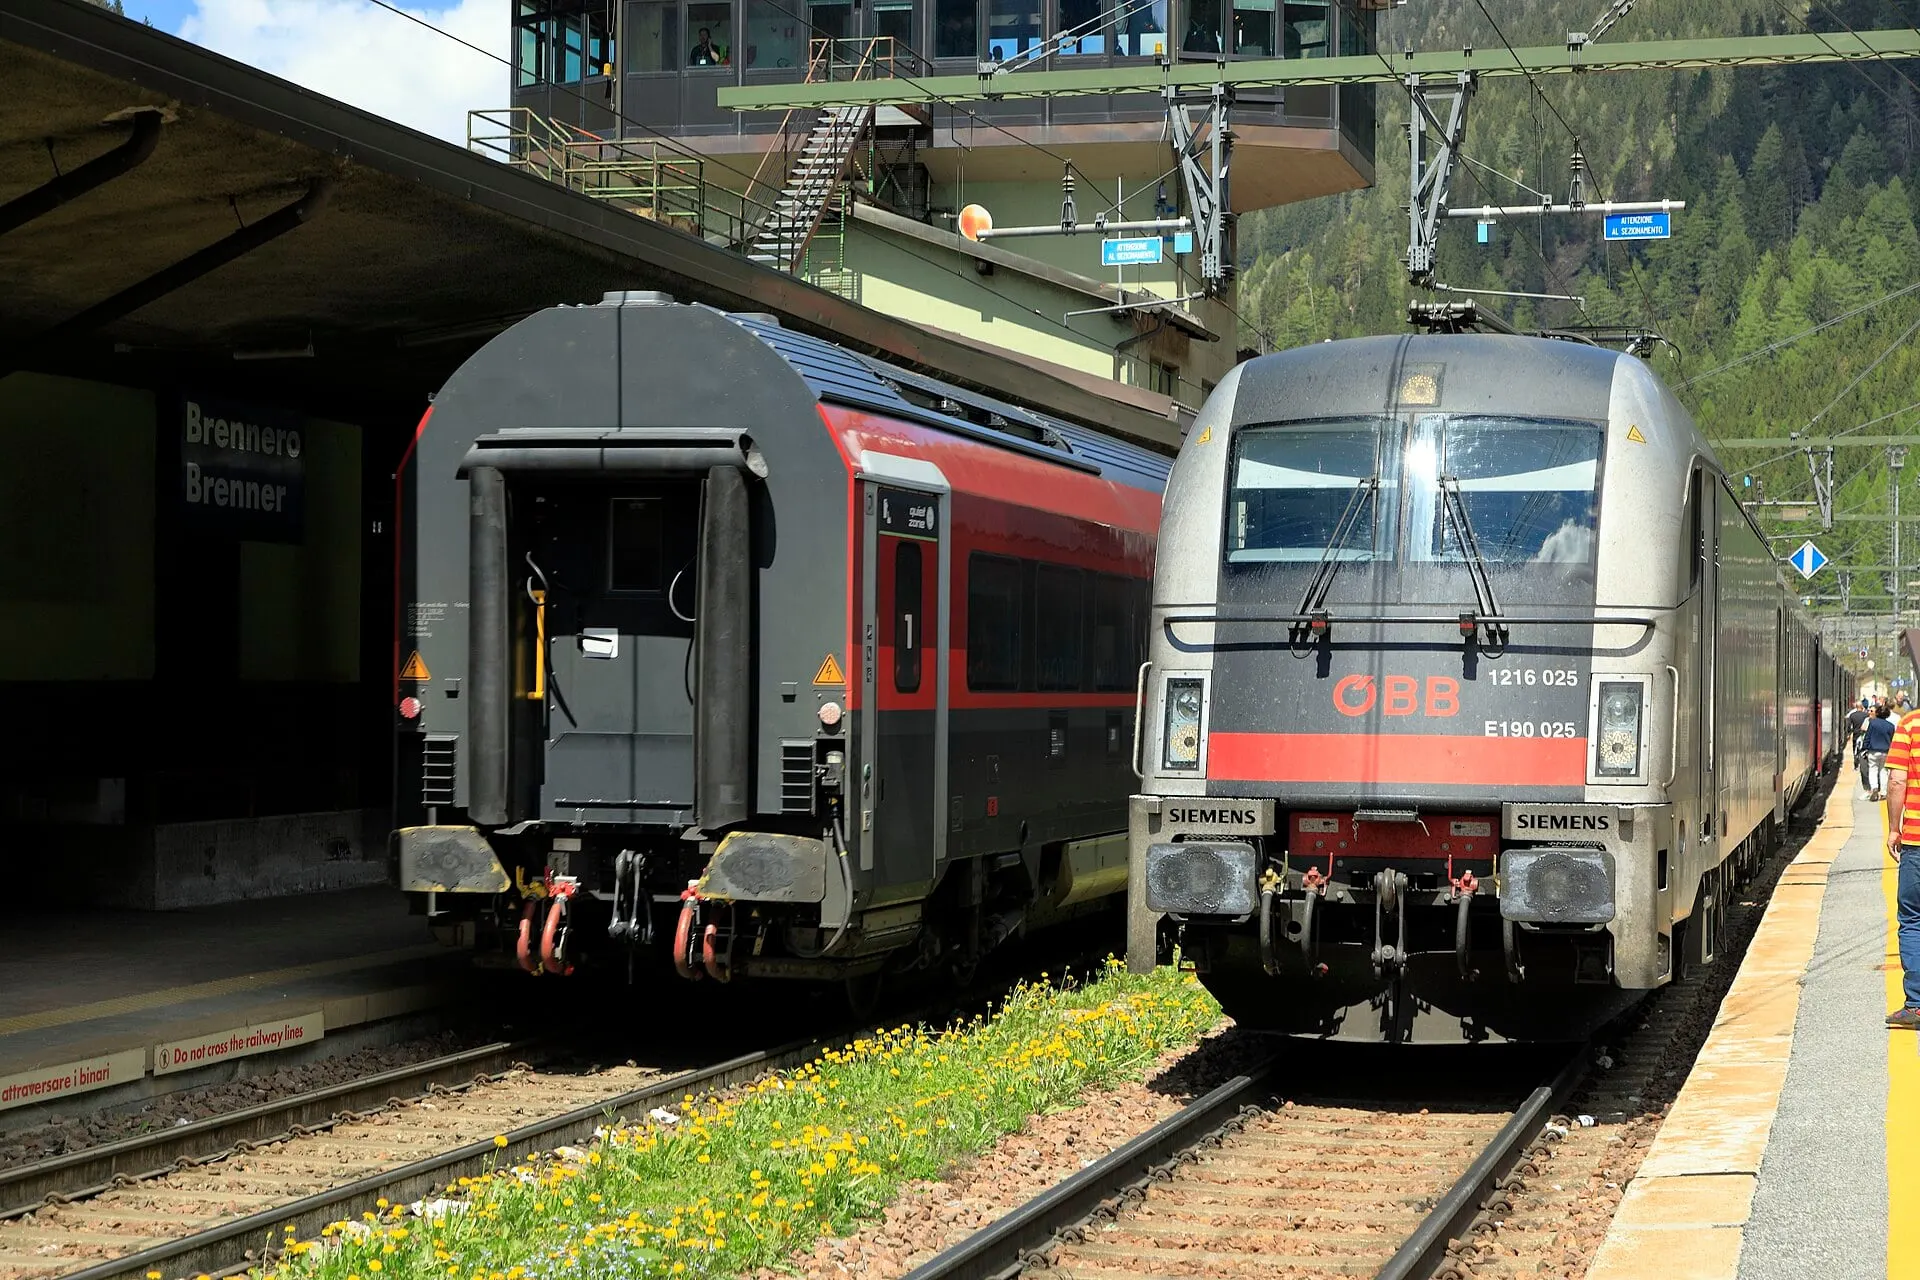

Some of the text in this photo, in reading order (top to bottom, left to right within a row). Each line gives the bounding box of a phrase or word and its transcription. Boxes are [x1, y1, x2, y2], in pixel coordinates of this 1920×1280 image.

[1621, 215, 1653, 224] ATTENZIONE
[1621, 226, 1663, 235] SEZIONAMENTO
[186, 401, 301, 458] Brennero
[186, 462, 287, 512] Brenner
[909, 506, 926, 518] quiet
[908, 519, 926, 529] zone
[904, 614, 913, 650] 1
[1488, 669, 1578, 687] 1216 025
[1333, 674, 1461, 717] ÖBB
[1484, 720, 1577, 738] E190 025
[1169, 808, 1256, 825] SIEMENS
[1517, 813, 1609, 831] SIEMENS
[174, 1024, 304, 1064] Do not cross the railway lines
[2, 1062, 110, 1102] attraversare i binari
